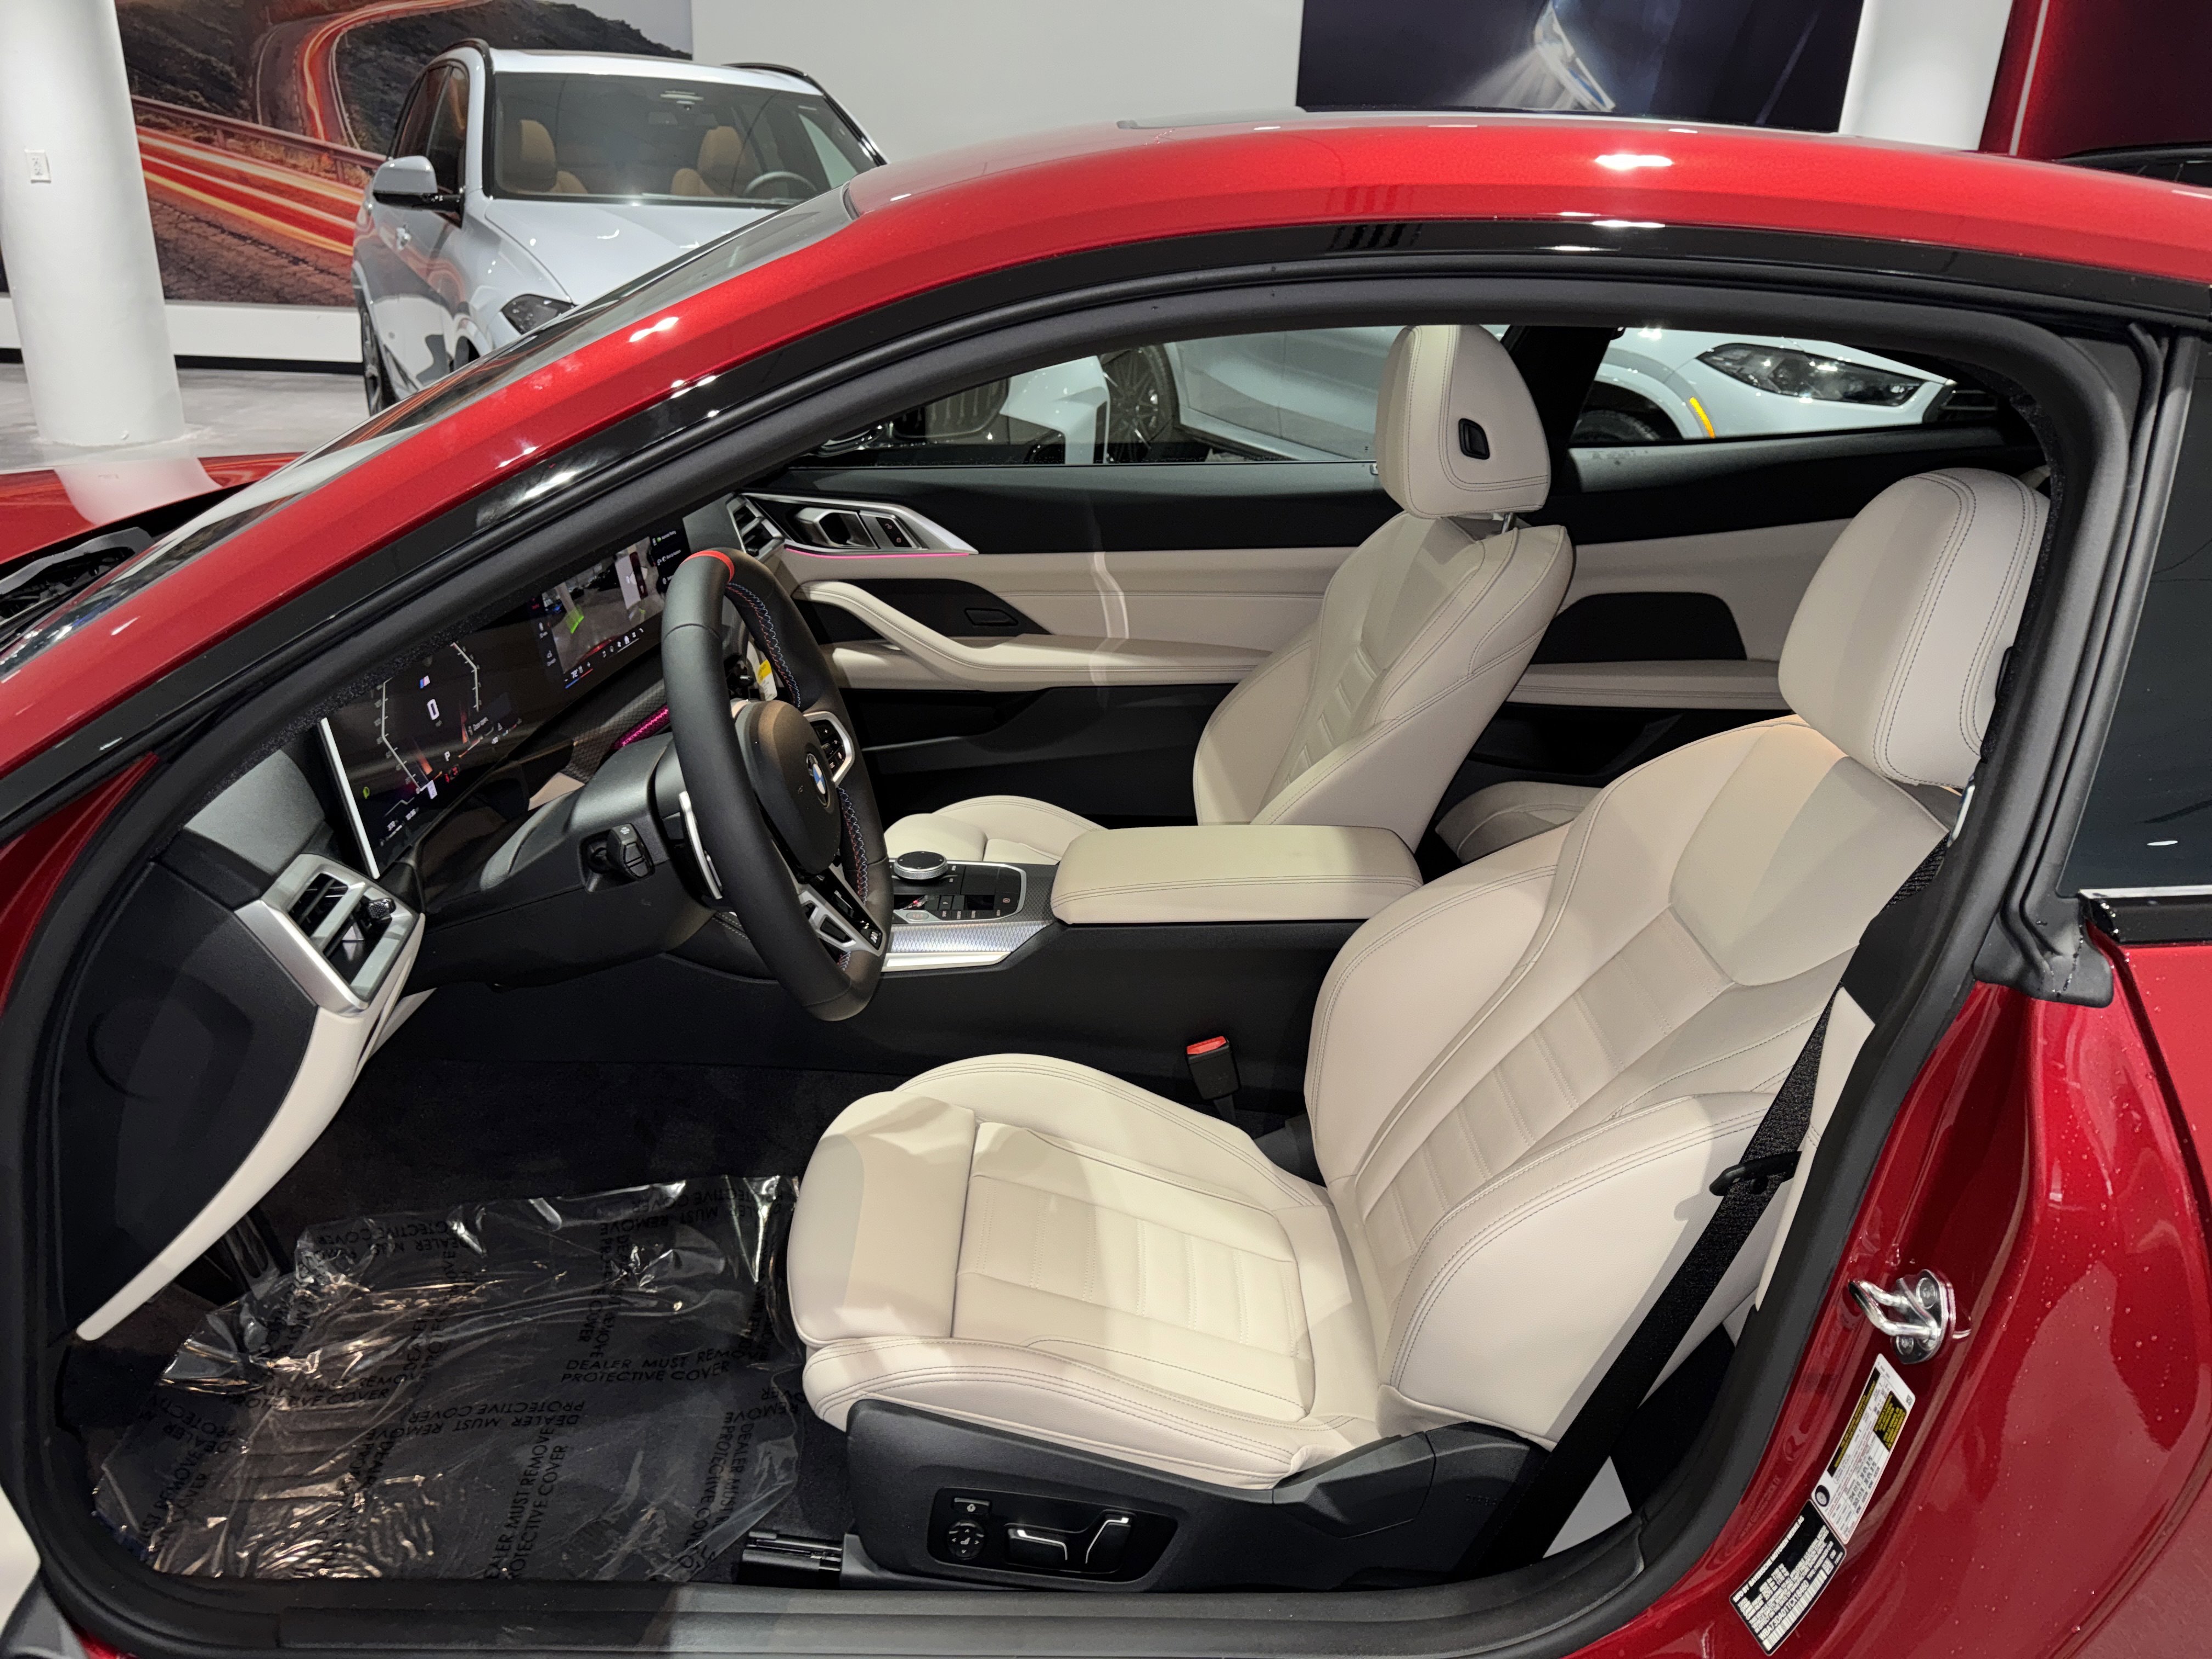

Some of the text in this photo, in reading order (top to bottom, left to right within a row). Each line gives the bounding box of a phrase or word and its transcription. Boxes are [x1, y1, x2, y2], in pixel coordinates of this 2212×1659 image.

[427, 698, 440, 720] 0
[443, 750, 451, 762] P
[599, 1214, 669, 1235] REMOVE
[561, 1360, 730, 1383] PROTECTIVE COVER
[566, 1359, 632, 1371] DEALER
[642, 1356, 686, 1369] MUST
[328, 1387, 389, 1404] COVER
[407, 1400, 584, 1423] PROTECTIVE COVER
[510, 1414, 579, 1426] DEALER
[452, 1417, 504, 1431] MUST
[729, 1423, 753, 1475] DEALER
[504, 1488, 532, 1528] MUST
[519, 1422, 555, 1486] REMOVE
[537, 1443, 568, 1497] COVER
[699, 1425, 735, 1506] PROTECTIVE
[719, 1476, 740, 1514] MUST
